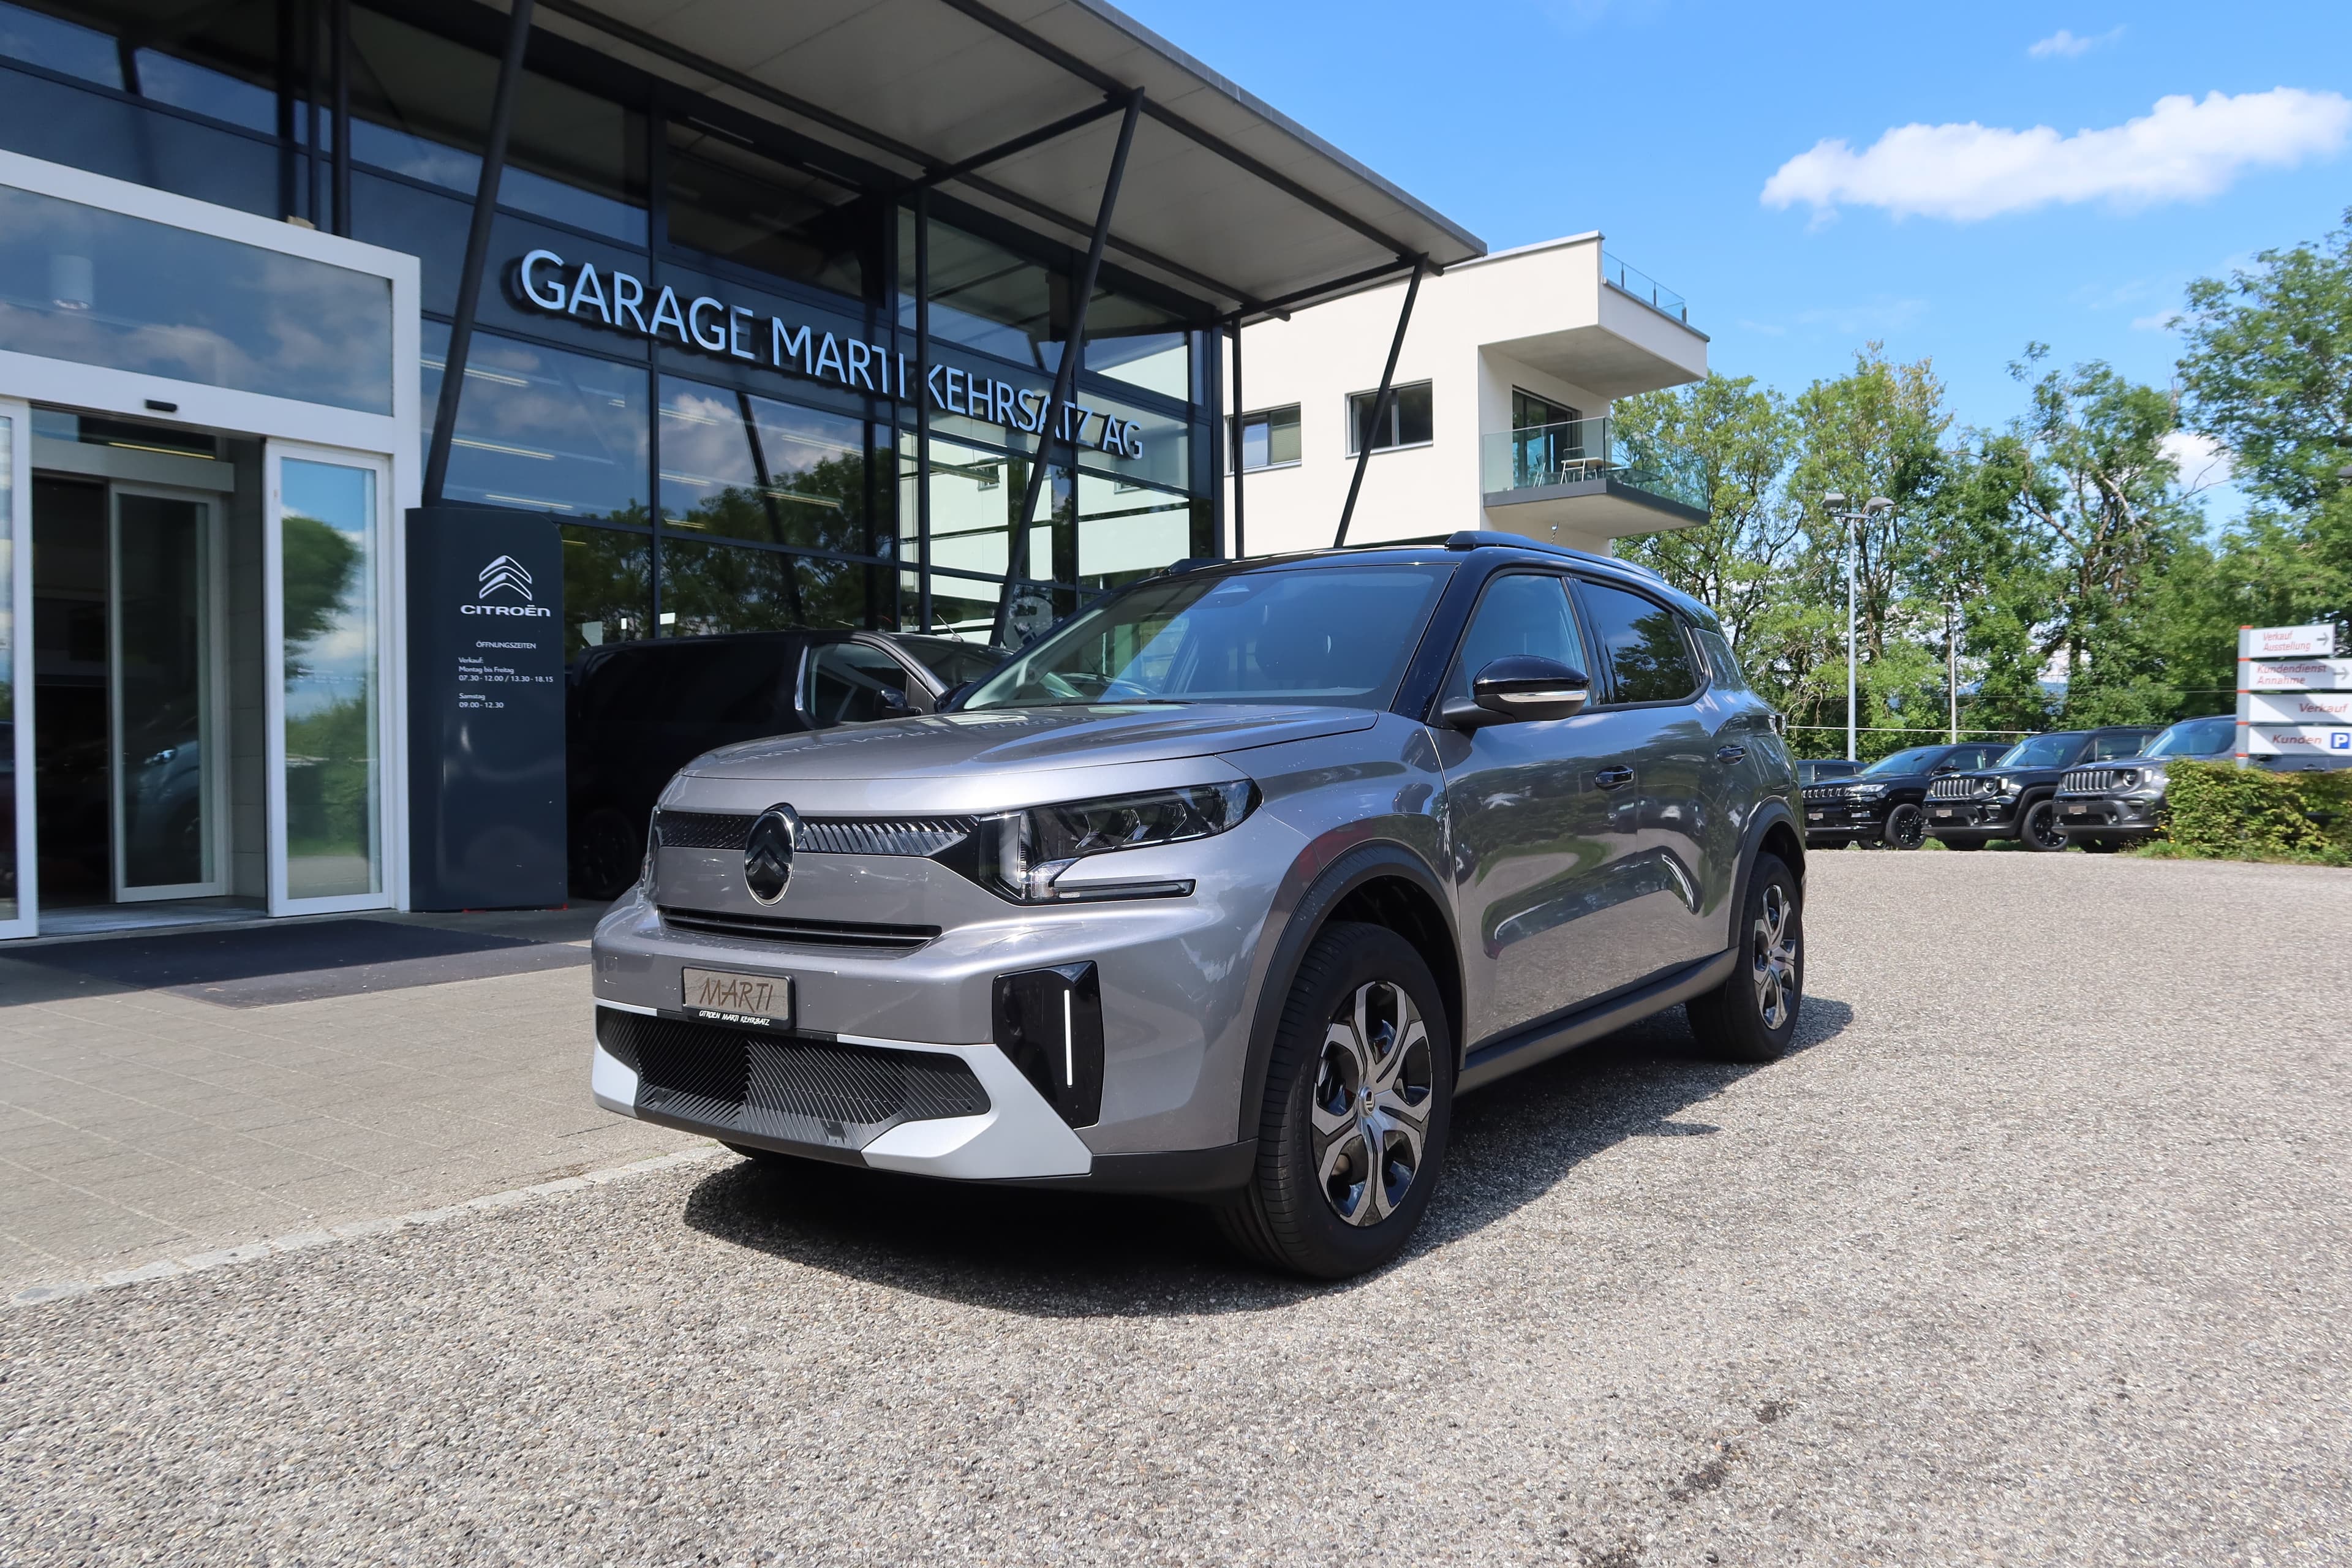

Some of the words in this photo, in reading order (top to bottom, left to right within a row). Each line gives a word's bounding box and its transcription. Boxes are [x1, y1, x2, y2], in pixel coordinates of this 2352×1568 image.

[521, 249, 755, 360] GARAGE
[772, 315, 905, 398] MARTI
[1102, 414, 1143, 459] AG
[460, 605, 551, 617] CITROËN
[2263, 631, 2293, 641] Verkauf
[475, 640, 537, 649] ÖFFNUNGSZEITEN
[2263, 641, 2311, 652] Ausstellung
[2257, 663, 2327, 673] Kundendienst
[2257, 676, 2305, 685] Annahme
[2299, 703, 2347, 713] Verkauf
[2272, 734, 2322, 744] Kunden
[2333, 734, 2350, 748] P
[699, 978, 774, 1014] MARTI
[721, 1013, 740, 1022] MARTI
